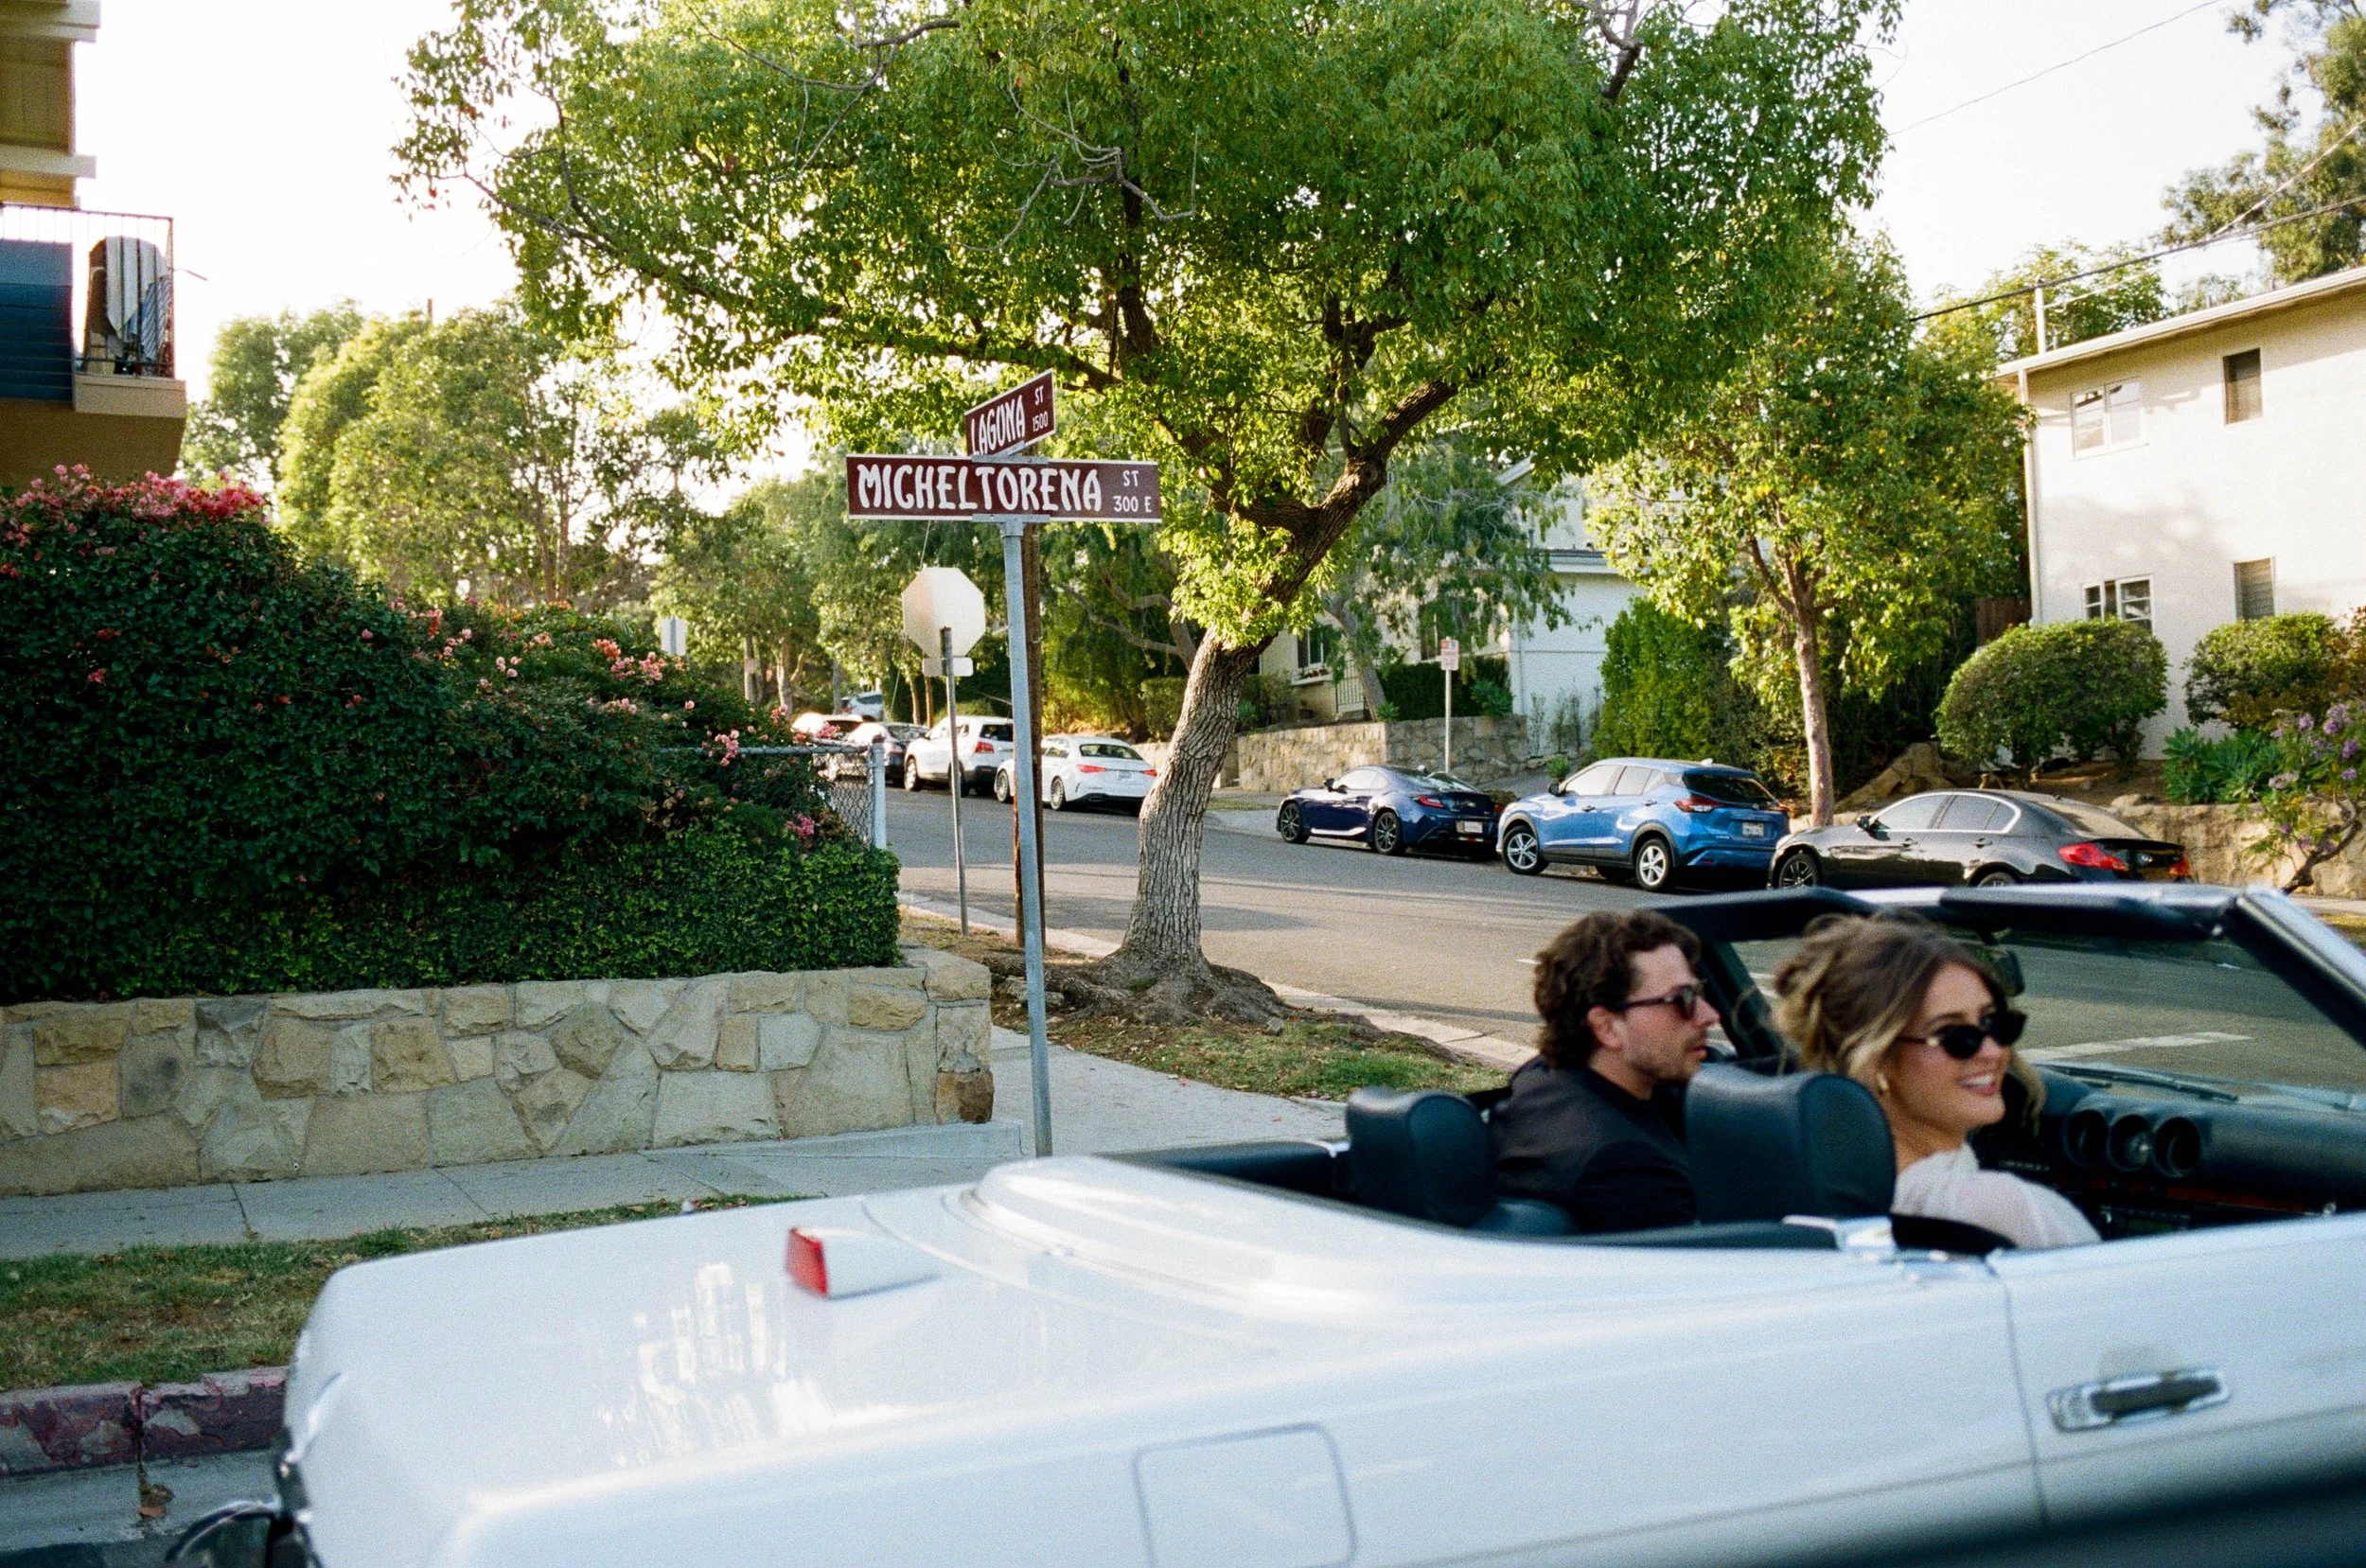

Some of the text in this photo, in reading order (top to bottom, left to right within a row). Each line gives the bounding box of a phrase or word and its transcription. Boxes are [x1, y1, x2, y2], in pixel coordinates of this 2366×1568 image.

[971, 385, 1045, 455] LAGUNA ST
[1033, 411, 1048, 432] 1500
[857, 464, 1139, 511] MICHELTORENA ST
[1113, 496, 1152, 513] 300 E
